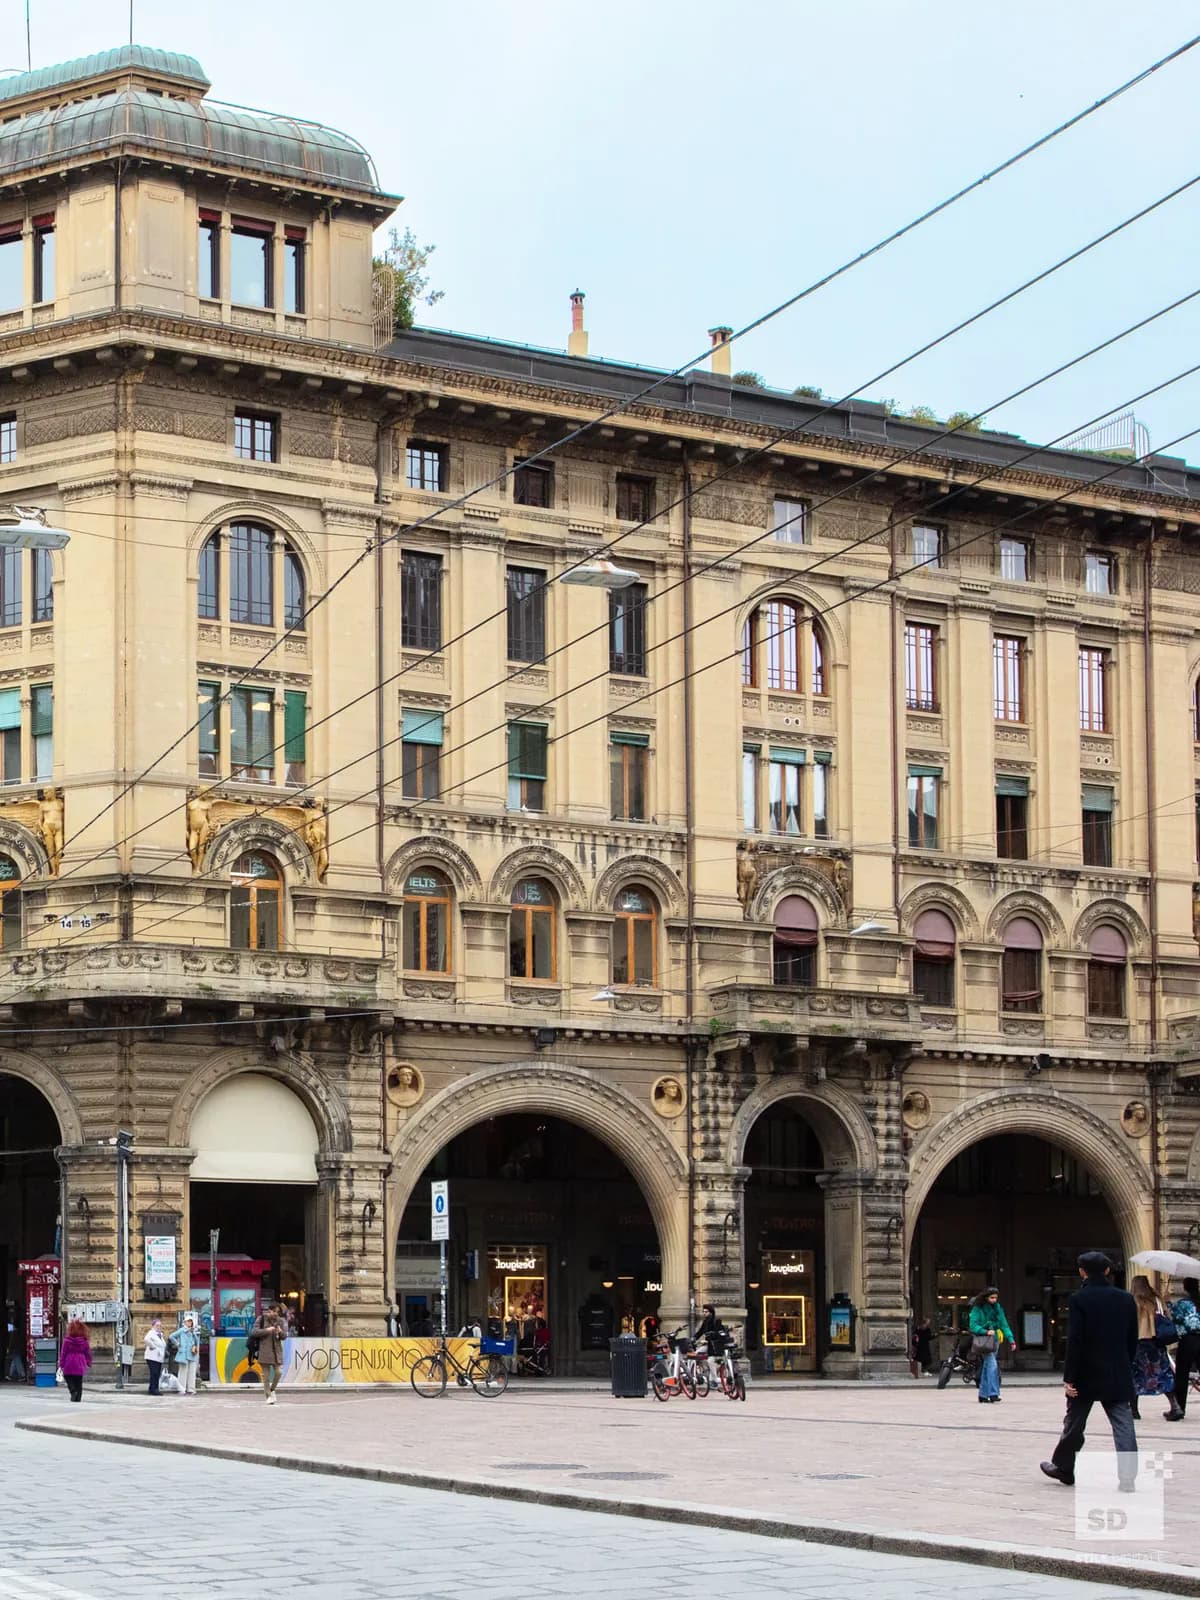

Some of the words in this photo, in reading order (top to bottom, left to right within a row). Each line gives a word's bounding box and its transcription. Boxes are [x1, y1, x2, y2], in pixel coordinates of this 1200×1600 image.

[409, 877, 437, 888] IELTS
[61, 919, 72, 928] 14
[80, 919, 91, 928] 15
[294, 1348, 423, 1371] MODERNISSIMO
